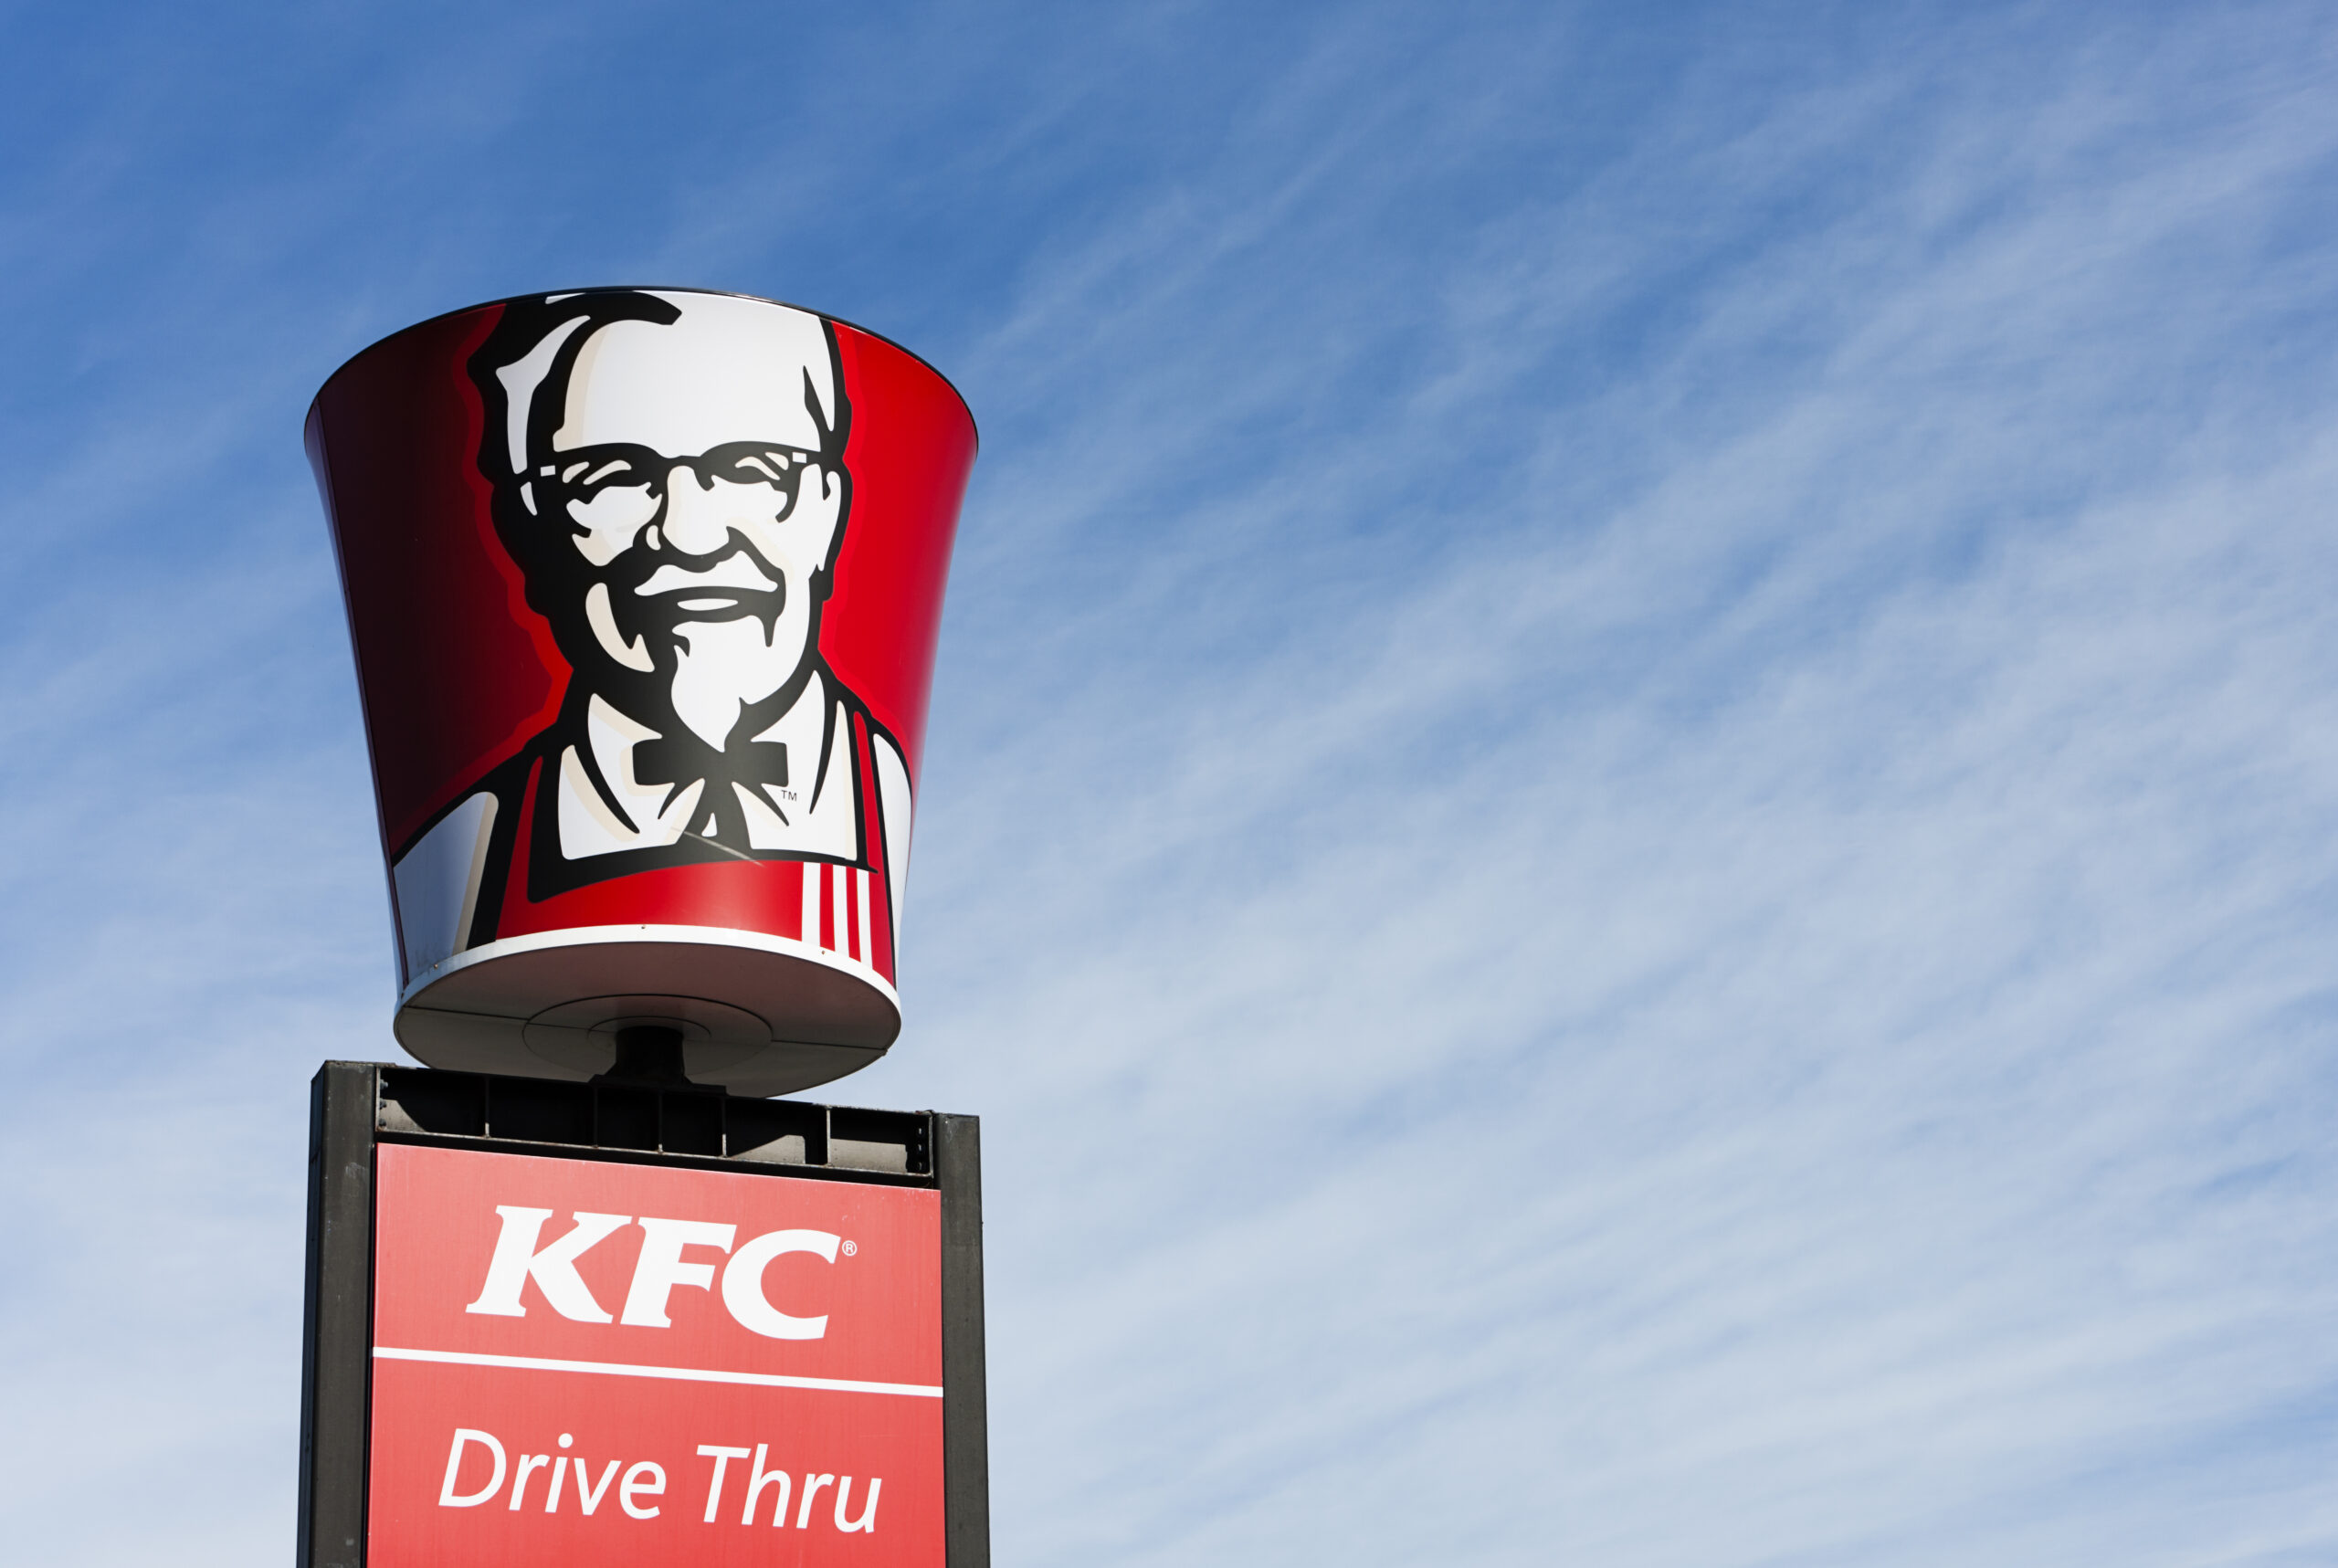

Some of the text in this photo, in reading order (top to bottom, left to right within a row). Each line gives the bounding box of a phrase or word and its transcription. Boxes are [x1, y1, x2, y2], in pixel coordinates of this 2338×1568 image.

[781, 789, 797, 802] TM
[437, 1427, 882, 1534] Drive Thru
